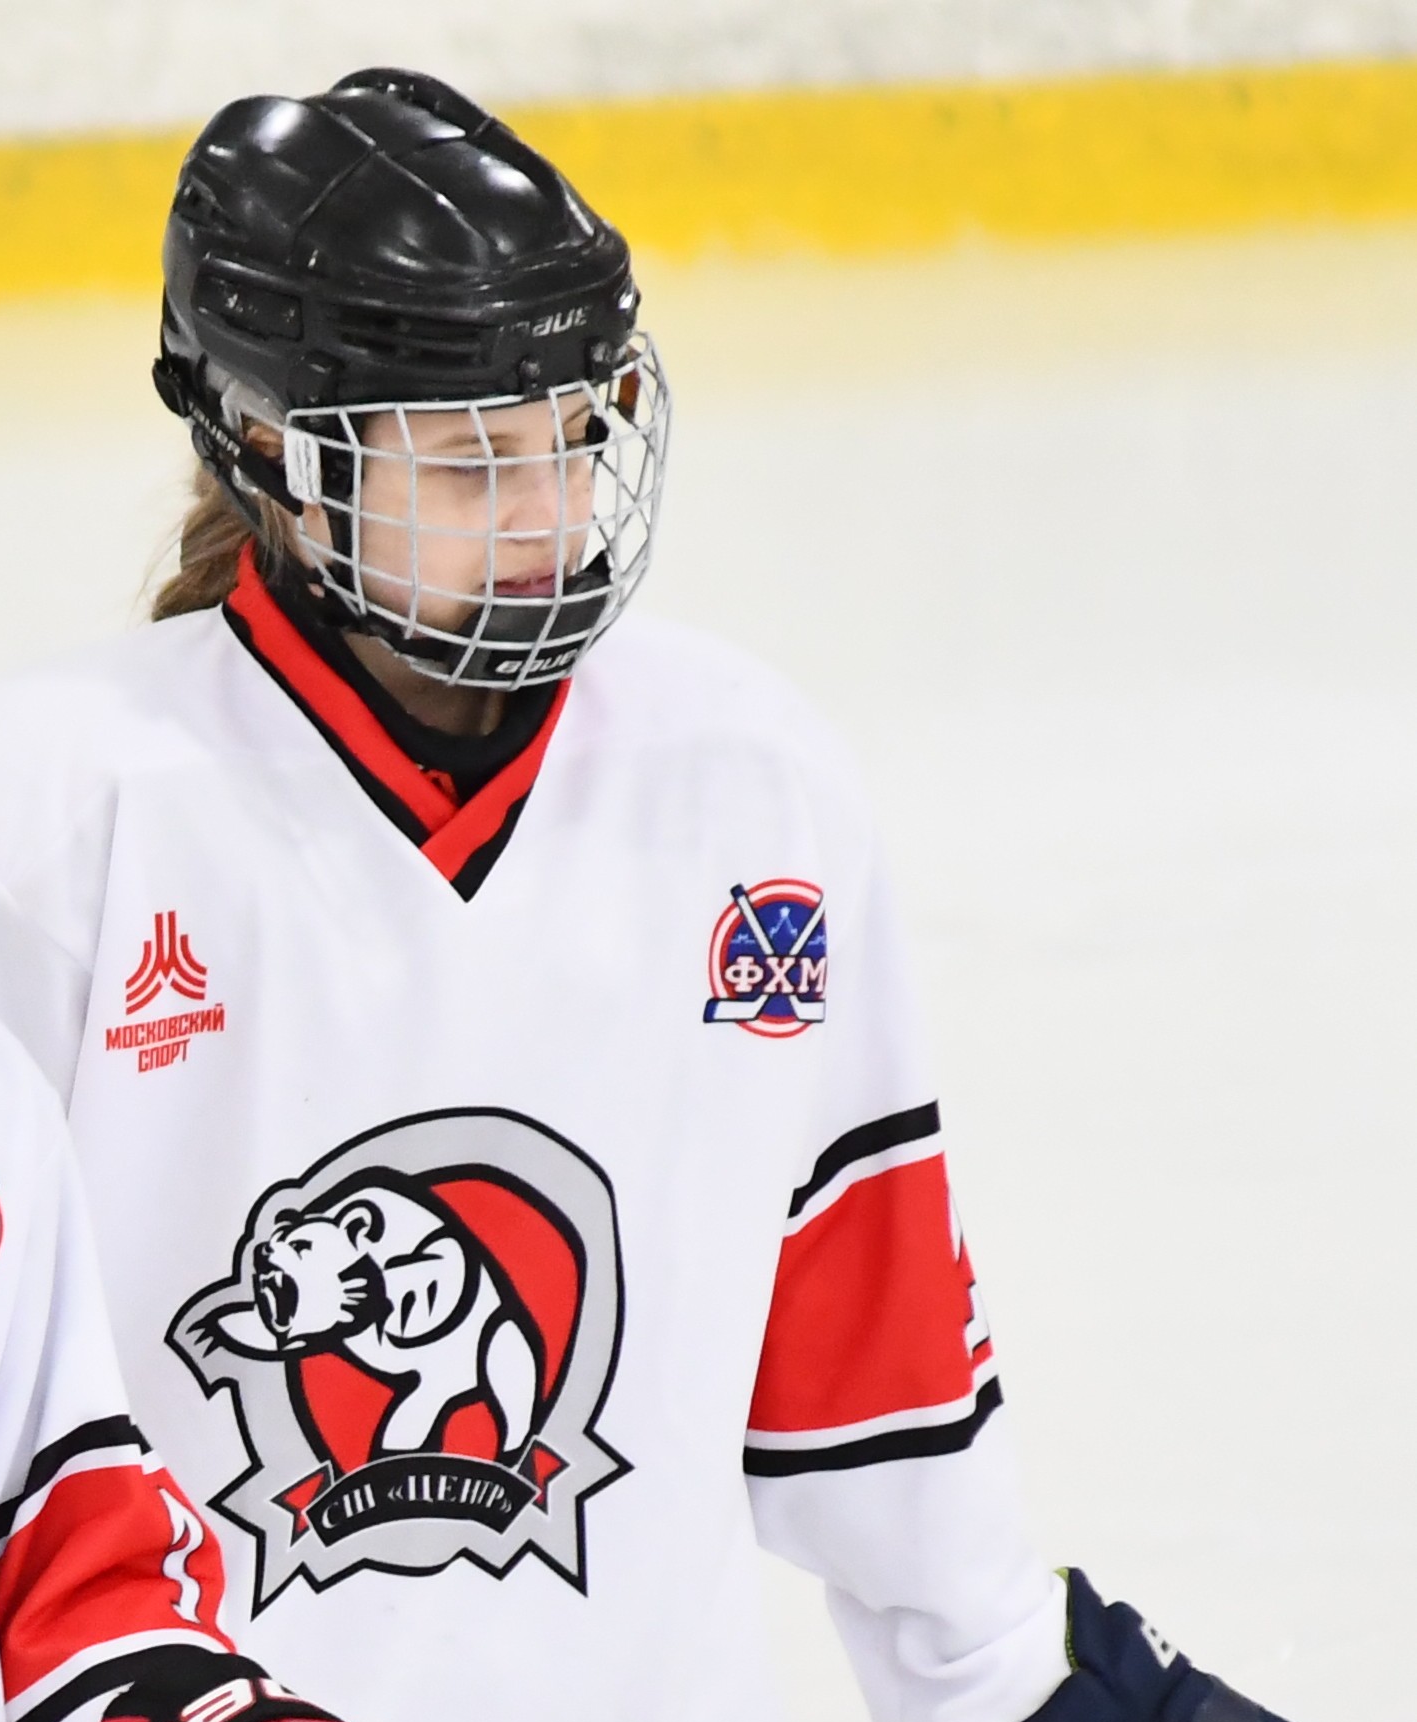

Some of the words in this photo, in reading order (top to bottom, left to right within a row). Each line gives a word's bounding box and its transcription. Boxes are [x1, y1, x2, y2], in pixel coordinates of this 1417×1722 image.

[724, 955, 826, 993] ФХМ
[106, 1003, 225, 1050] МОСКОВСКИЙ
[138, 1039, 190, 1073] СПОРТ
[321, 1483, 376, 1529] СШ
